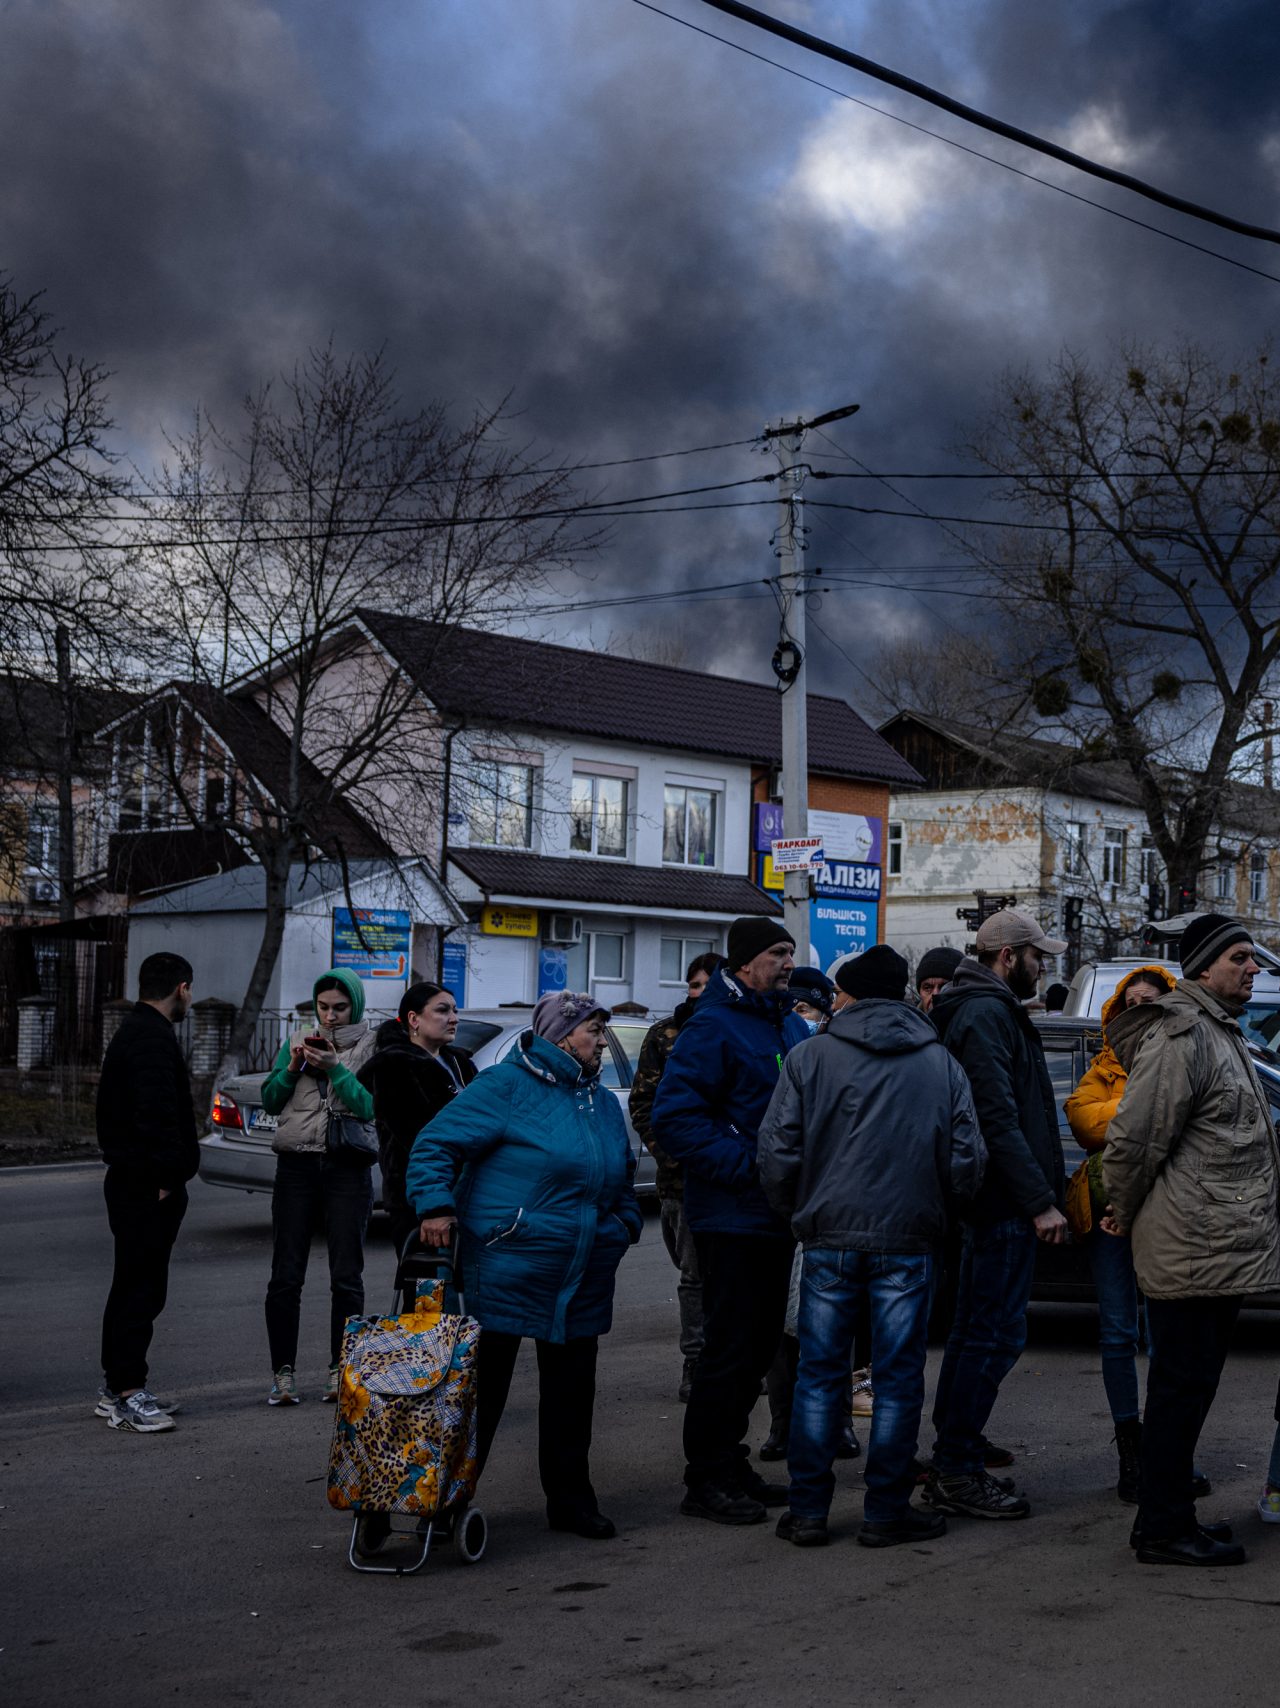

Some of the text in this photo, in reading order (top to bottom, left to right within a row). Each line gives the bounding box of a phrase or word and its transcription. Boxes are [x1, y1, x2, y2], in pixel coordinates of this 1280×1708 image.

[777, 838, 821, 849] НАРКОЛОГ
[816, 908, 867, 922] БІЛЬШІСТЬ
[834, 924, 866, 936] ТЕСТІВ
